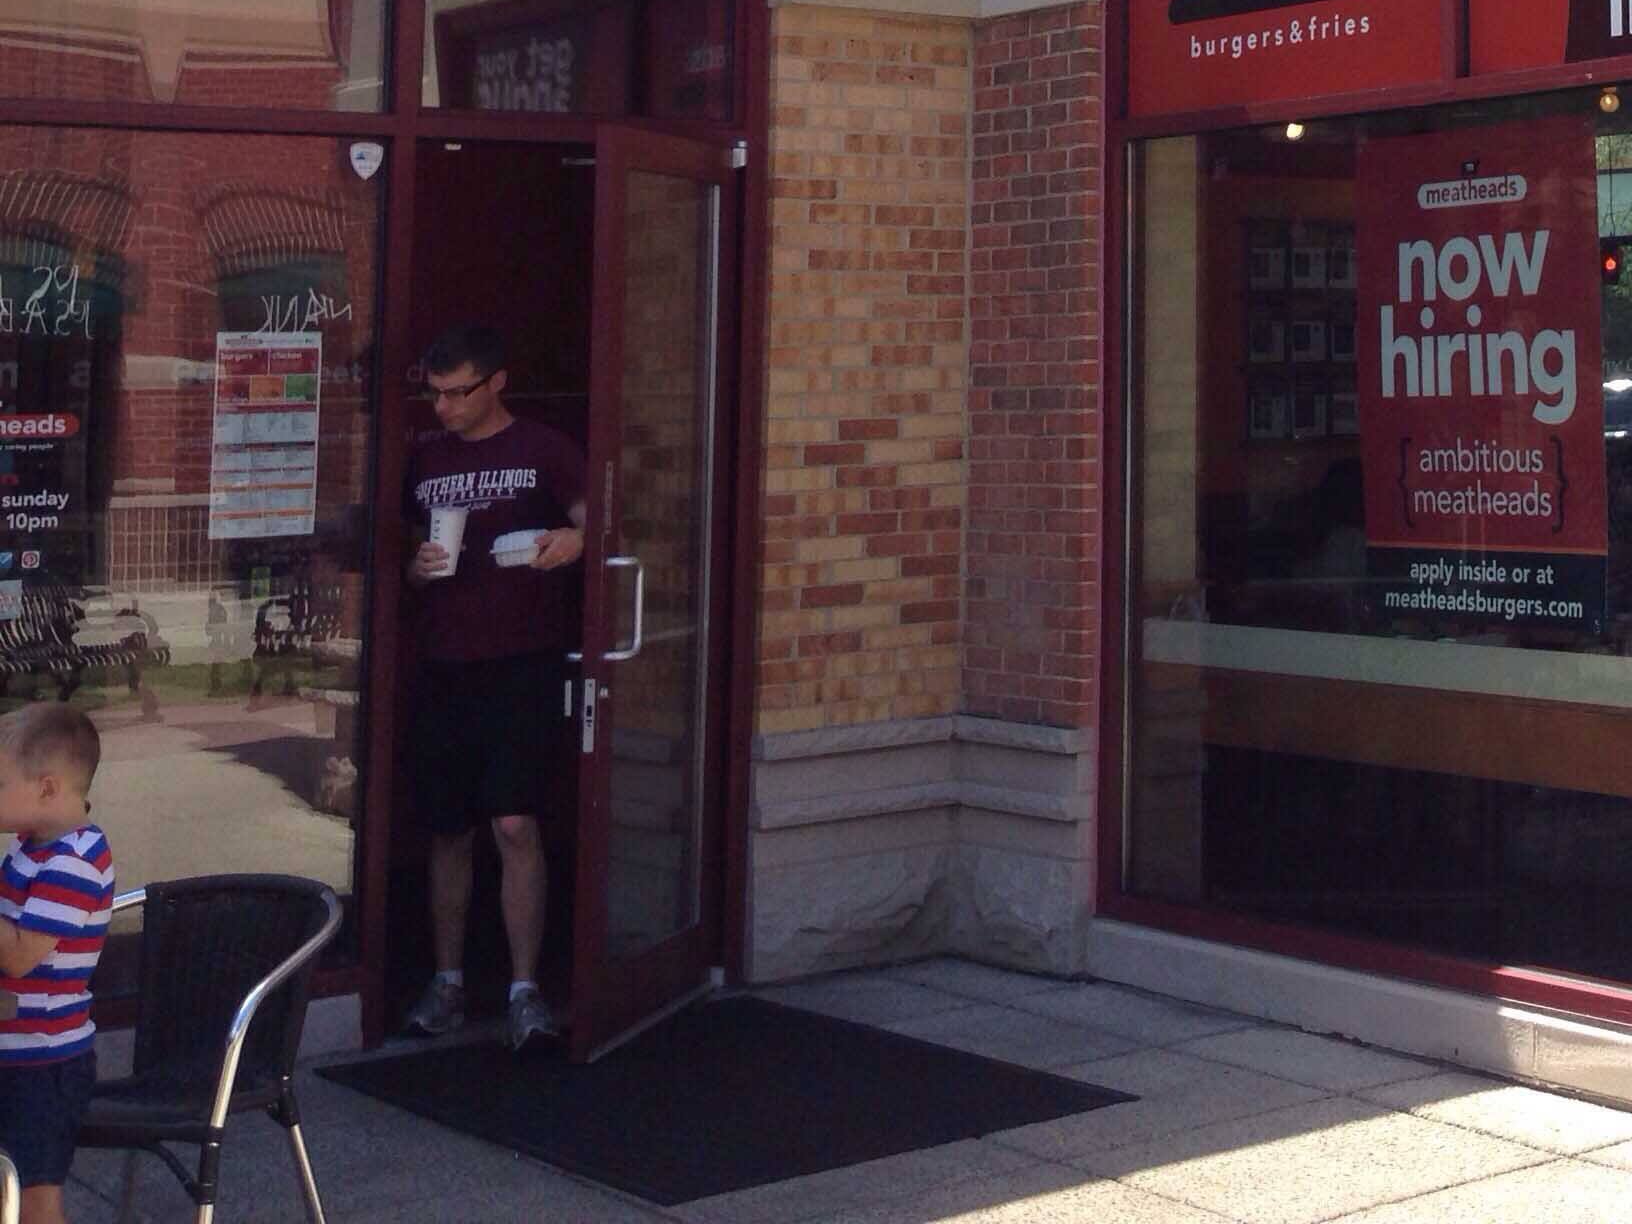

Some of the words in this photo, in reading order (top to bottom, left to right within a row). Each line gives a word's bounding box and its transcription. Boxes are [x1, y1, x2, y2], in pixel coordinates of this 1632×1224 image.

[1426, 176, 1518, 205] meatheads
[1398, 229, 1550, 303] now
[1380, 304, 1577, 425] hiring
[1418, 437, 1543, 473] ambitious
[477, 468, 537, 489] ILLINOIS
[2, 489, 70, 510] sunday
[1413, 479, 1552, 517] meatheads
[6, 513, 59, 533] 10pm
[1410, 557, 1454, 586] apply
[1458, 559, 1506, 583] inside
[1512, 570, 1531, 584] or
[1536, 564, 1554, 585] at
[1384, 587, 1584, 620] meatheadsburgers.com
